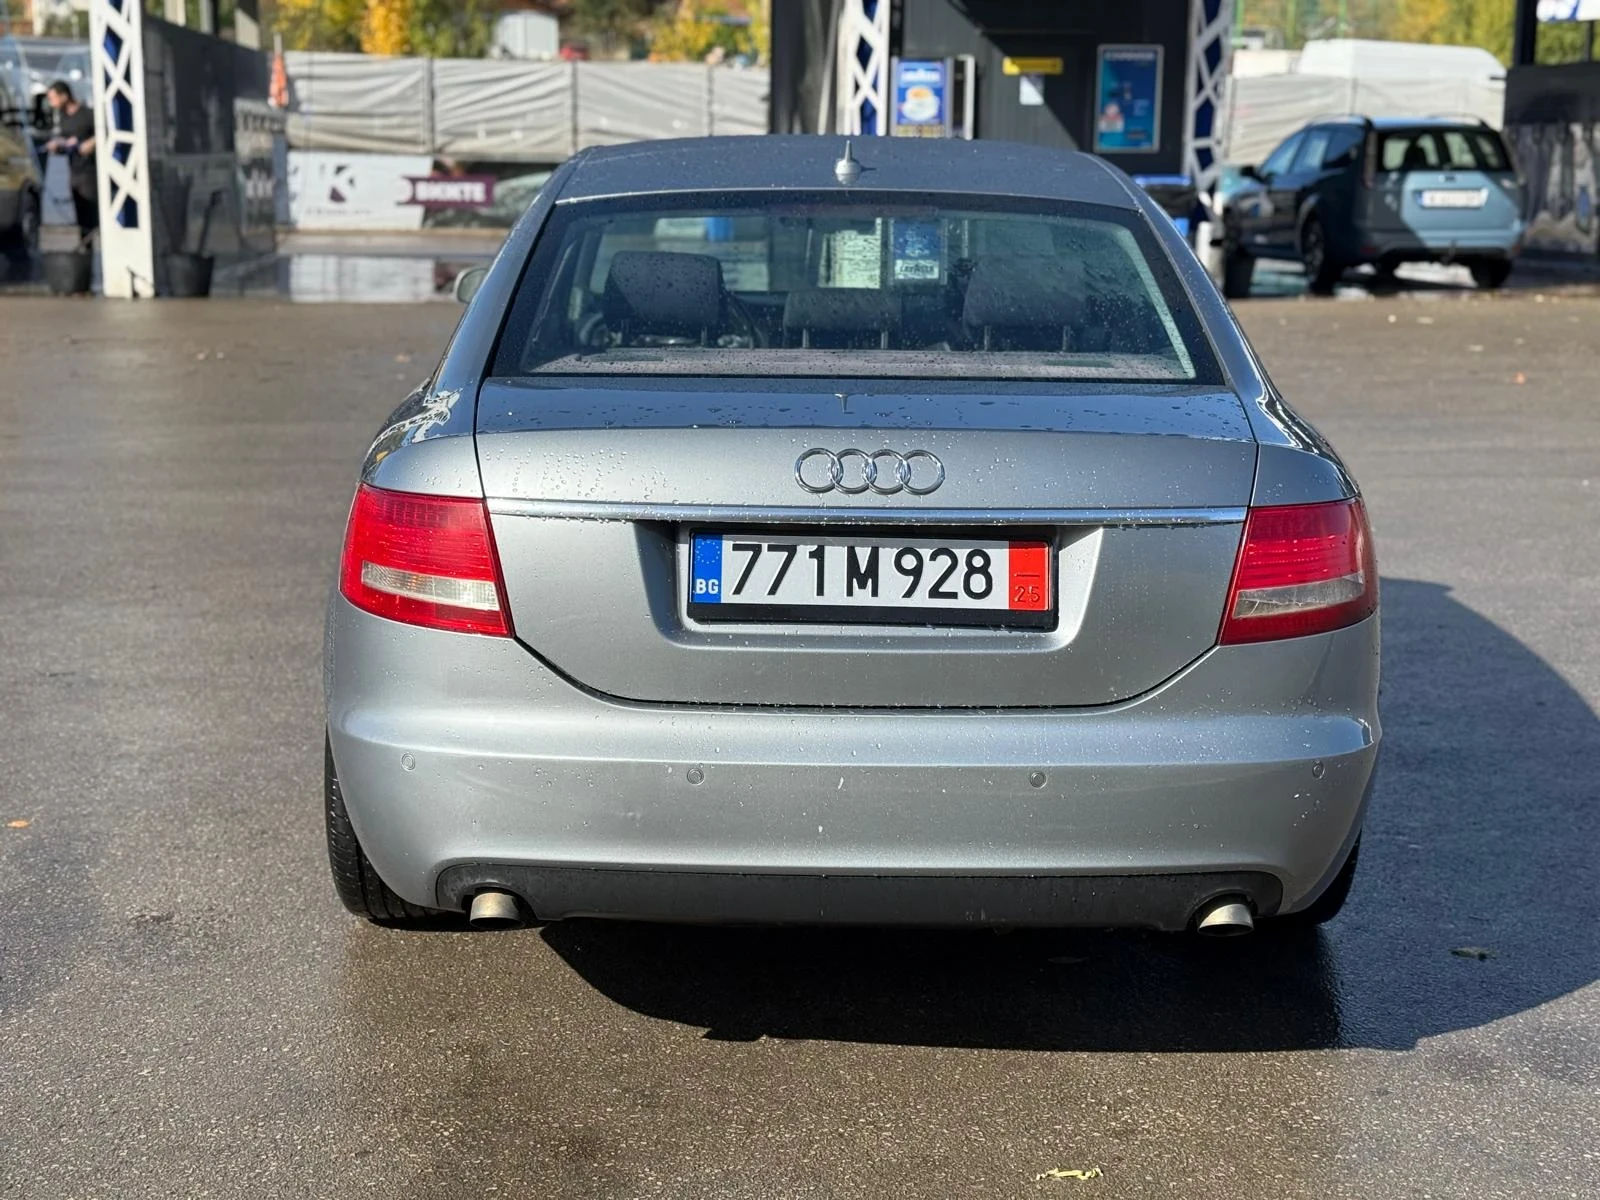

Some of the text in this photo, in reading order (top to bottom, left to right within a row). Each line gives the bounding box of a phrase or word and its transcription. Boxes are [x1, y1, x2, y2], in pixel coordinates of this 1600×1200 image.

[732, 543, 993, 600] 771 M 928
[695, 578, 719, 595] BG
[1014, 585, 1041, 603] 25
